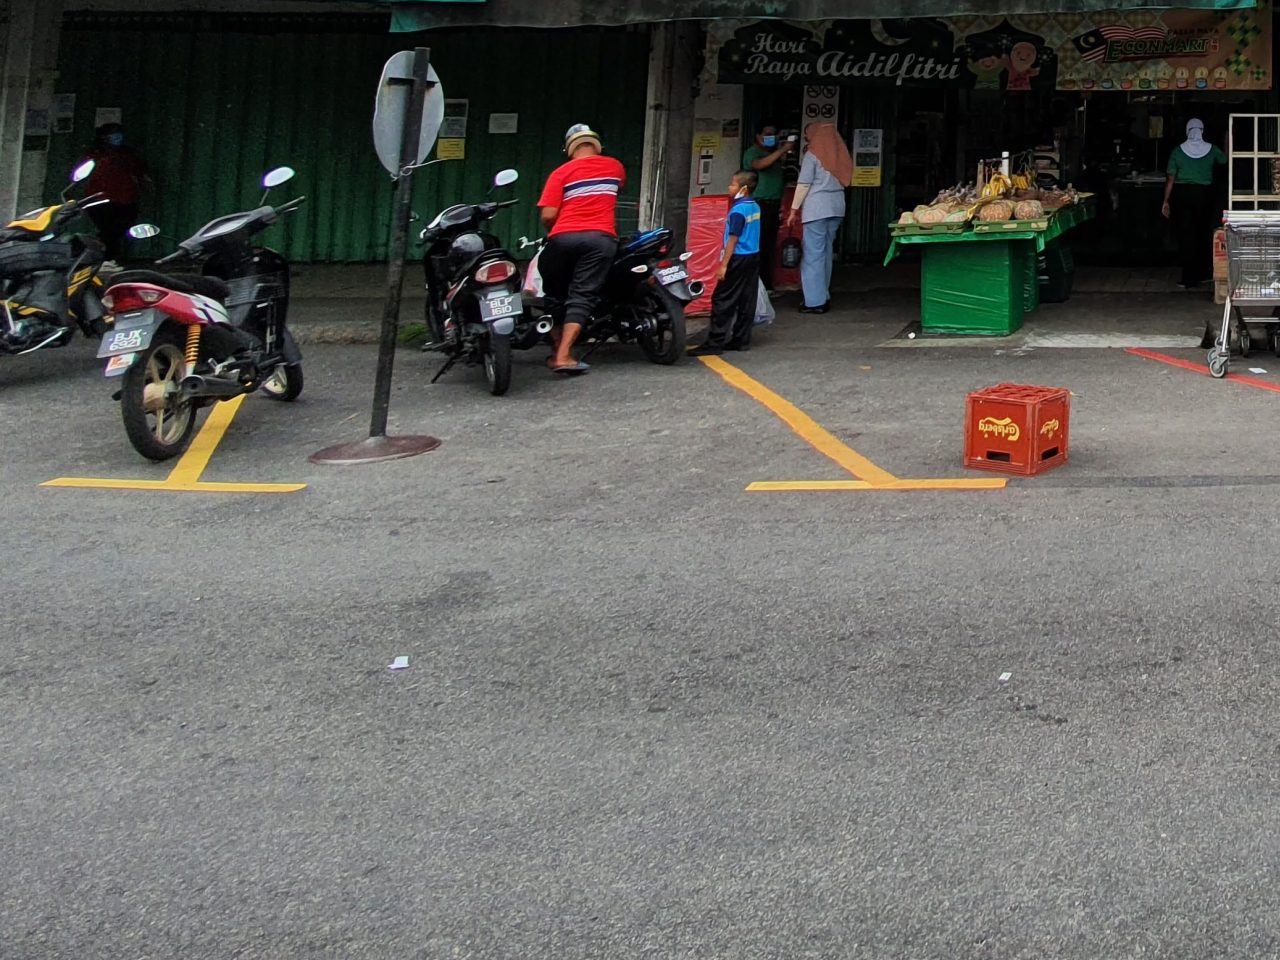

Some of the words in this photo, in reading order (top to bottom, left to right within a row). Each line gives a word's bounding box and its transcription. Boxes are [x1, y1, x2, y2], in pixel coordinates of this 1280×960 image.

[751, 32, 808, 54] Hari
[1104, 38, 1209, 63] ECONMART
[743, 53, 812, 81] Raya
[816, 50, 961, 86] Aidilfitri
[978, 417, 1020, 441] Carlsberg
